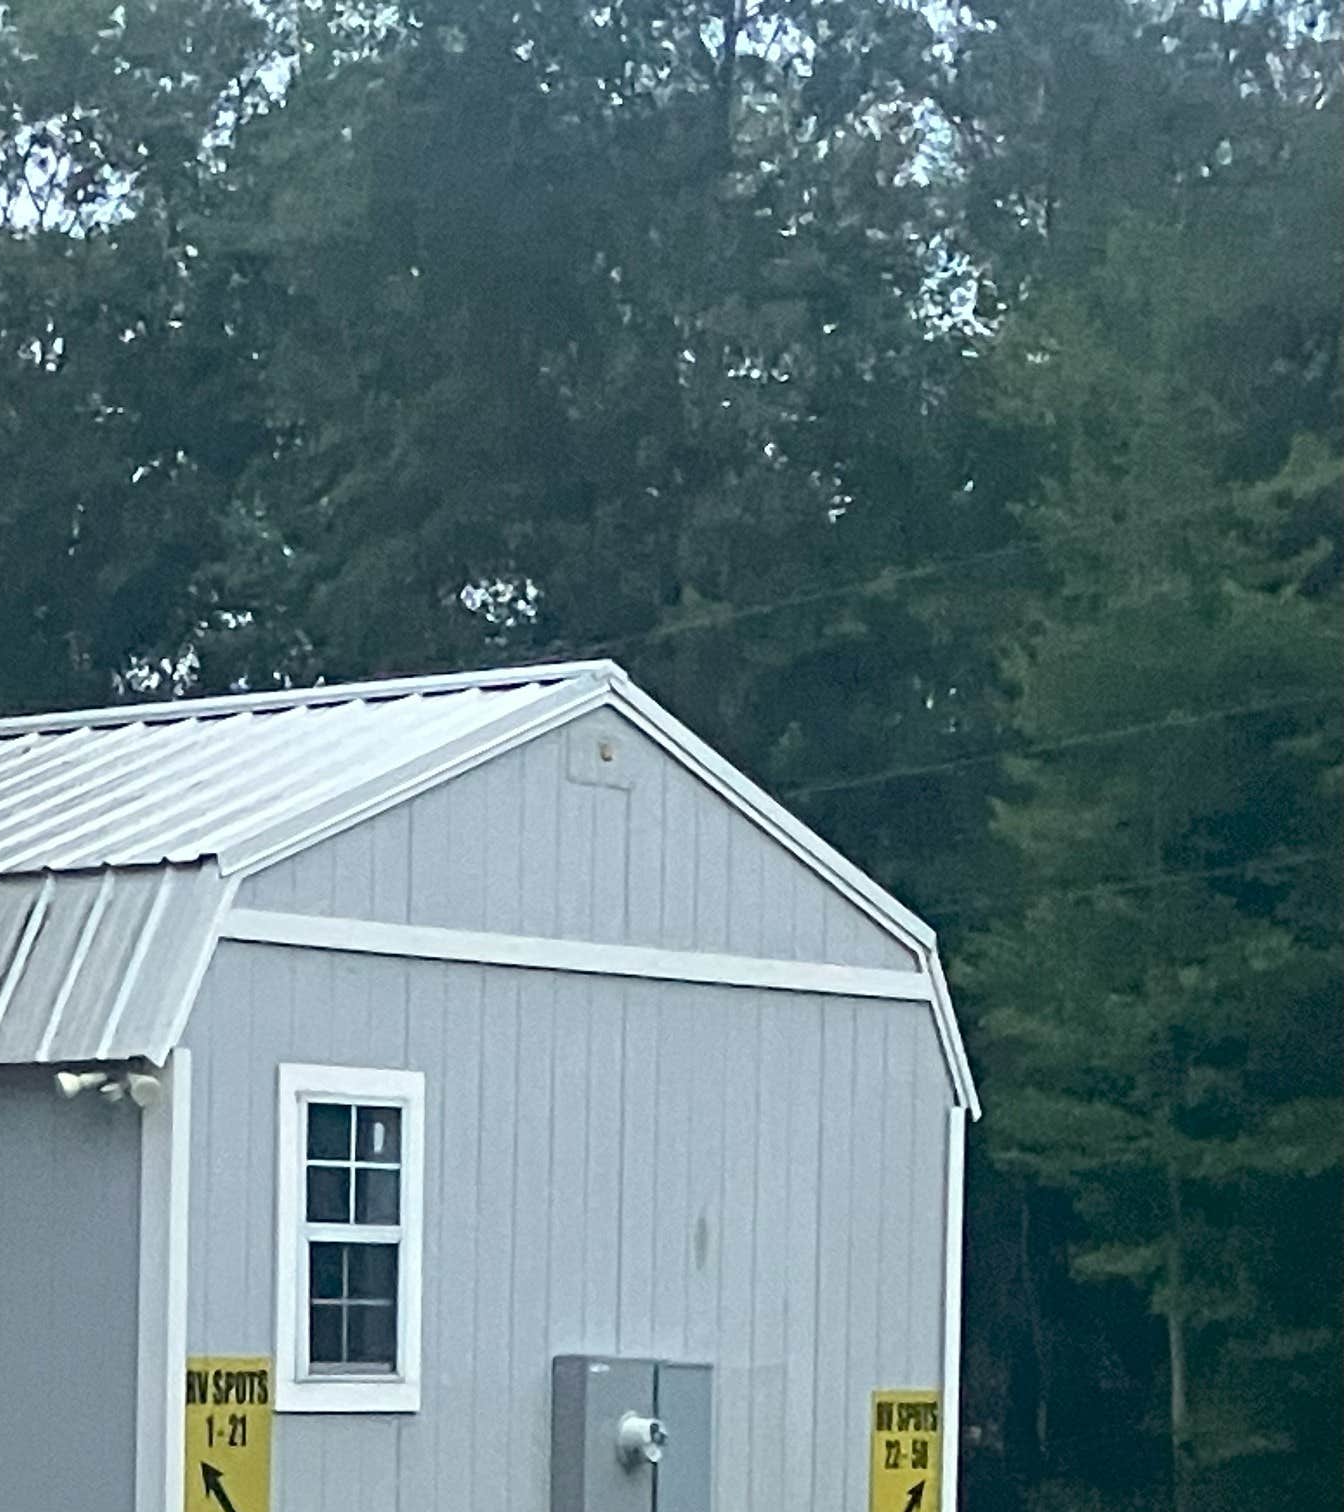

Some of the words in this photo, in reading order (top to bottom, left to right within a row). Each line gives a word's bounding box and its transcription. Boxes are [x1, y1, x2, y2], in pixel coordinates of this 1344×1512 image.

[186, 1370, 209, 1405] RV
[213, 1369, 268, 1405] SPOTS
[897, 1402, 938, 1431] SPOTS
